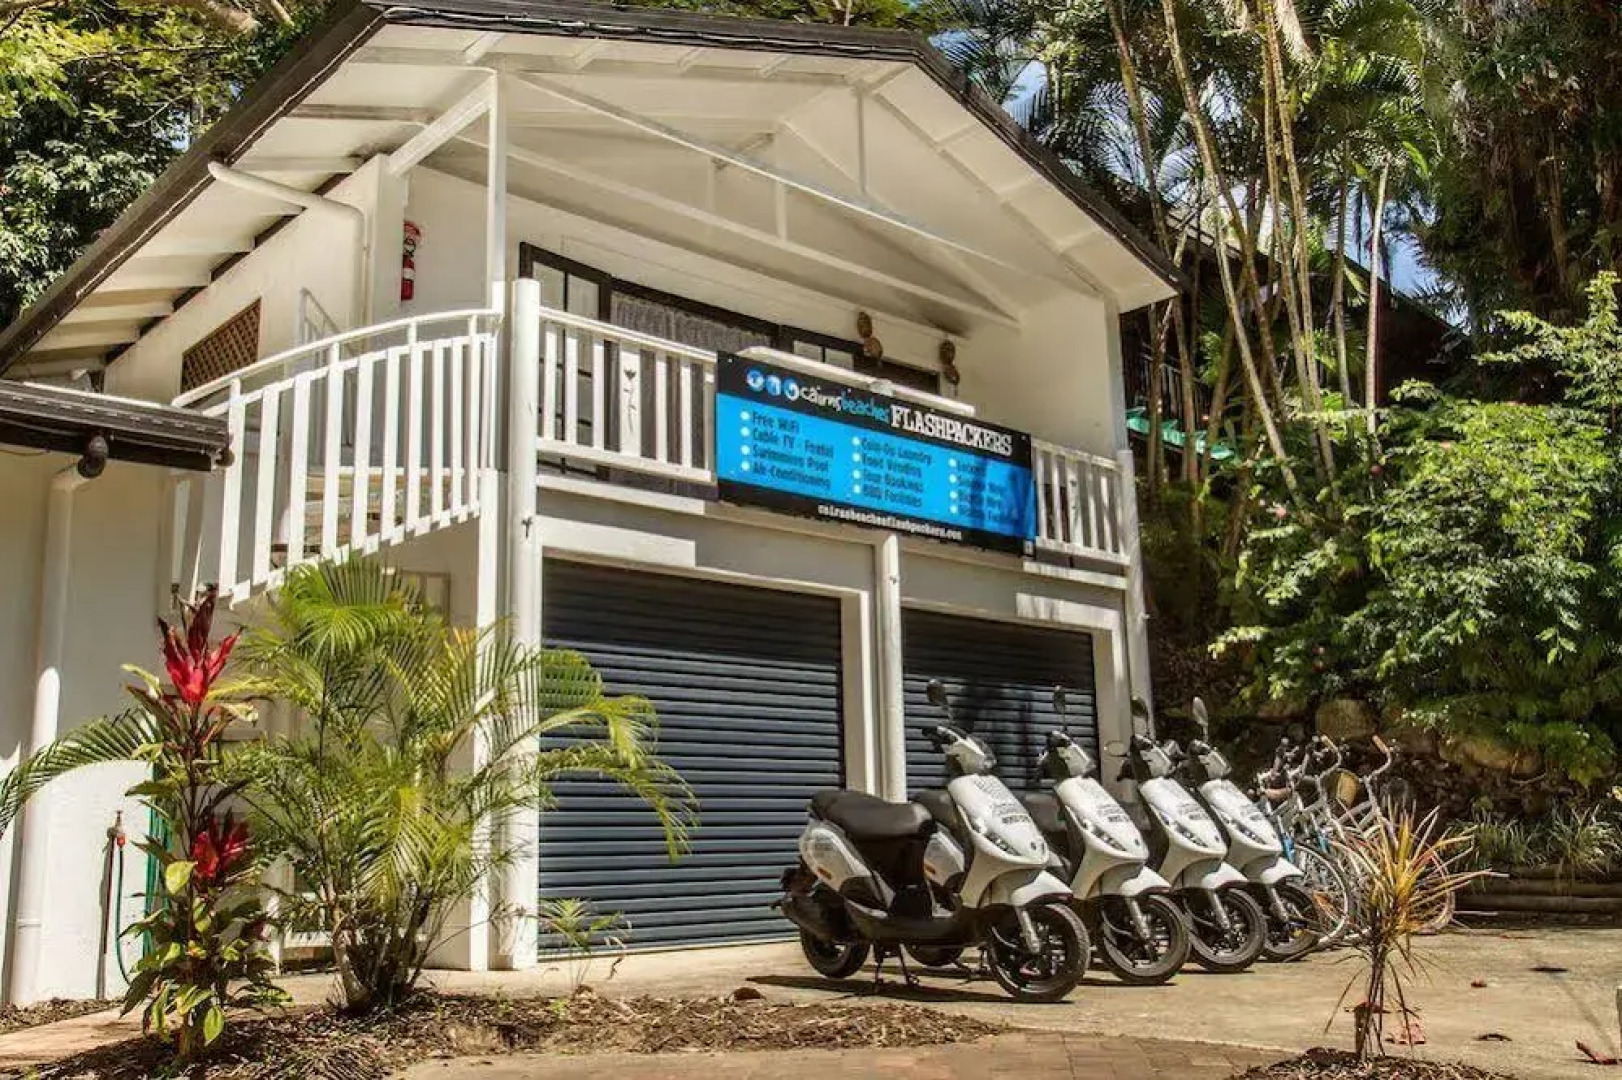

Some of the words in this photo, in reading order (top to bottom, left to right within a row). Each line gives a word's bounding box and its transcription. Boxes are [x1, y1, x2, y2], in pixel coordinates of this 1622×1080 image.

[753, 411, 775, 428] Free
[890, 404, 1013, 456] FLASHPACKERS
[784, 435, 795, 448] TV
